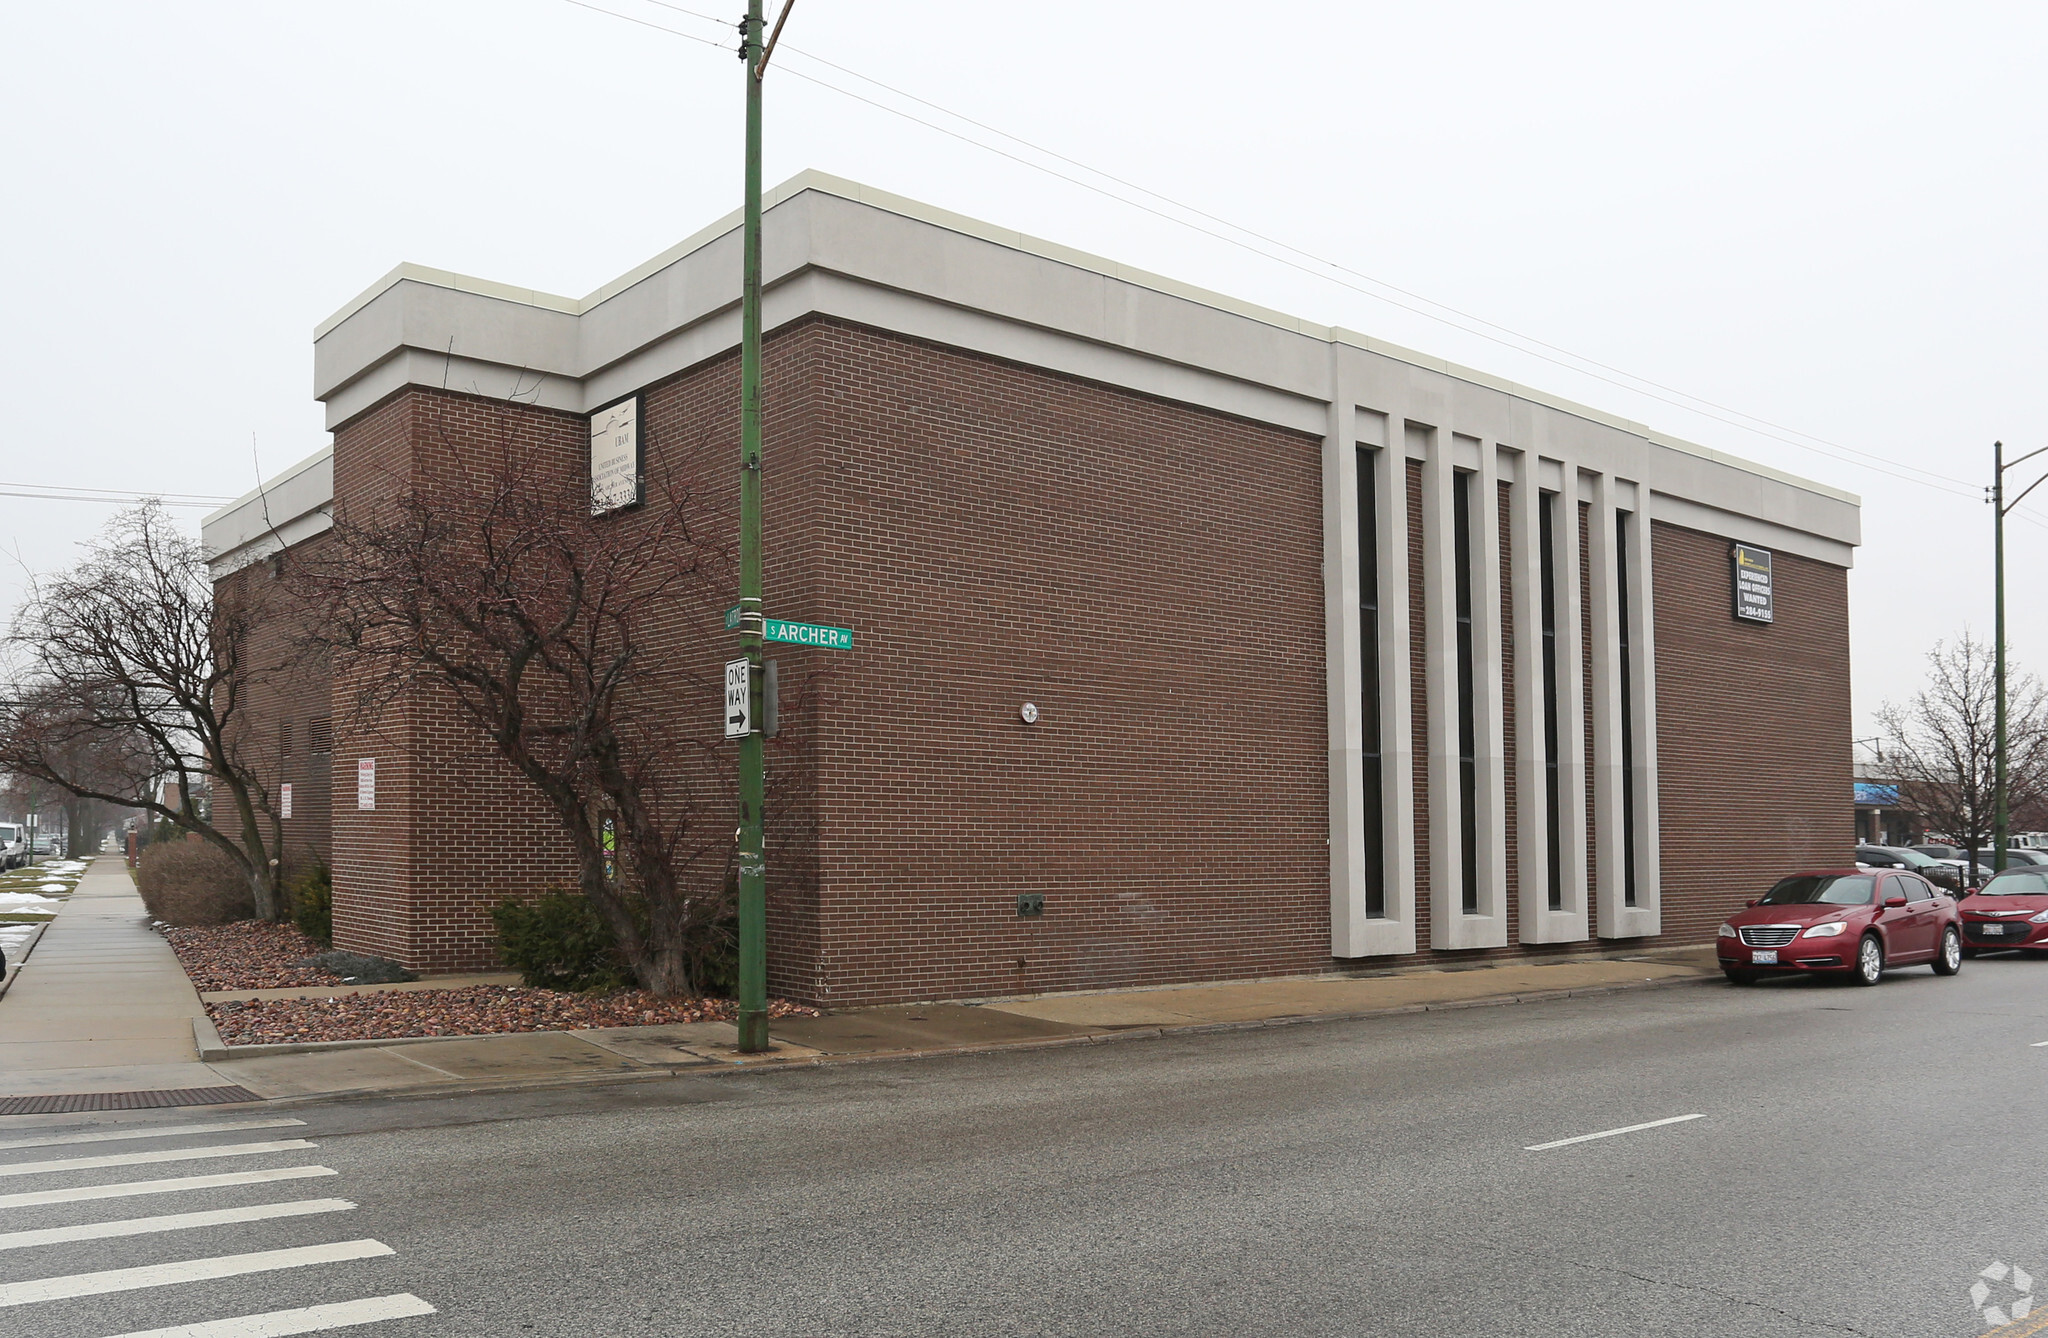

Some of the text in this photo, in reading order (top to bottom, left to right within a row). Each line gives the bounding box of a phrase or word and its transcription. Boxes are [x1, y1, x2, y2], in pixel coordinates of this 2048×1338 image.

[615, 433, 629, 447] UBAM
[598, 453, 628, 470] UNITED BUSINESS
[1739, 581, 1771, 595] LOAN OFFICERS
[1743, 593, 1767, 605] WANTED
[771, 623, 848, 646] S ARCHER AV
[728, 666, 746, 686] ONE
[728, 687, 747, 707] WAY
